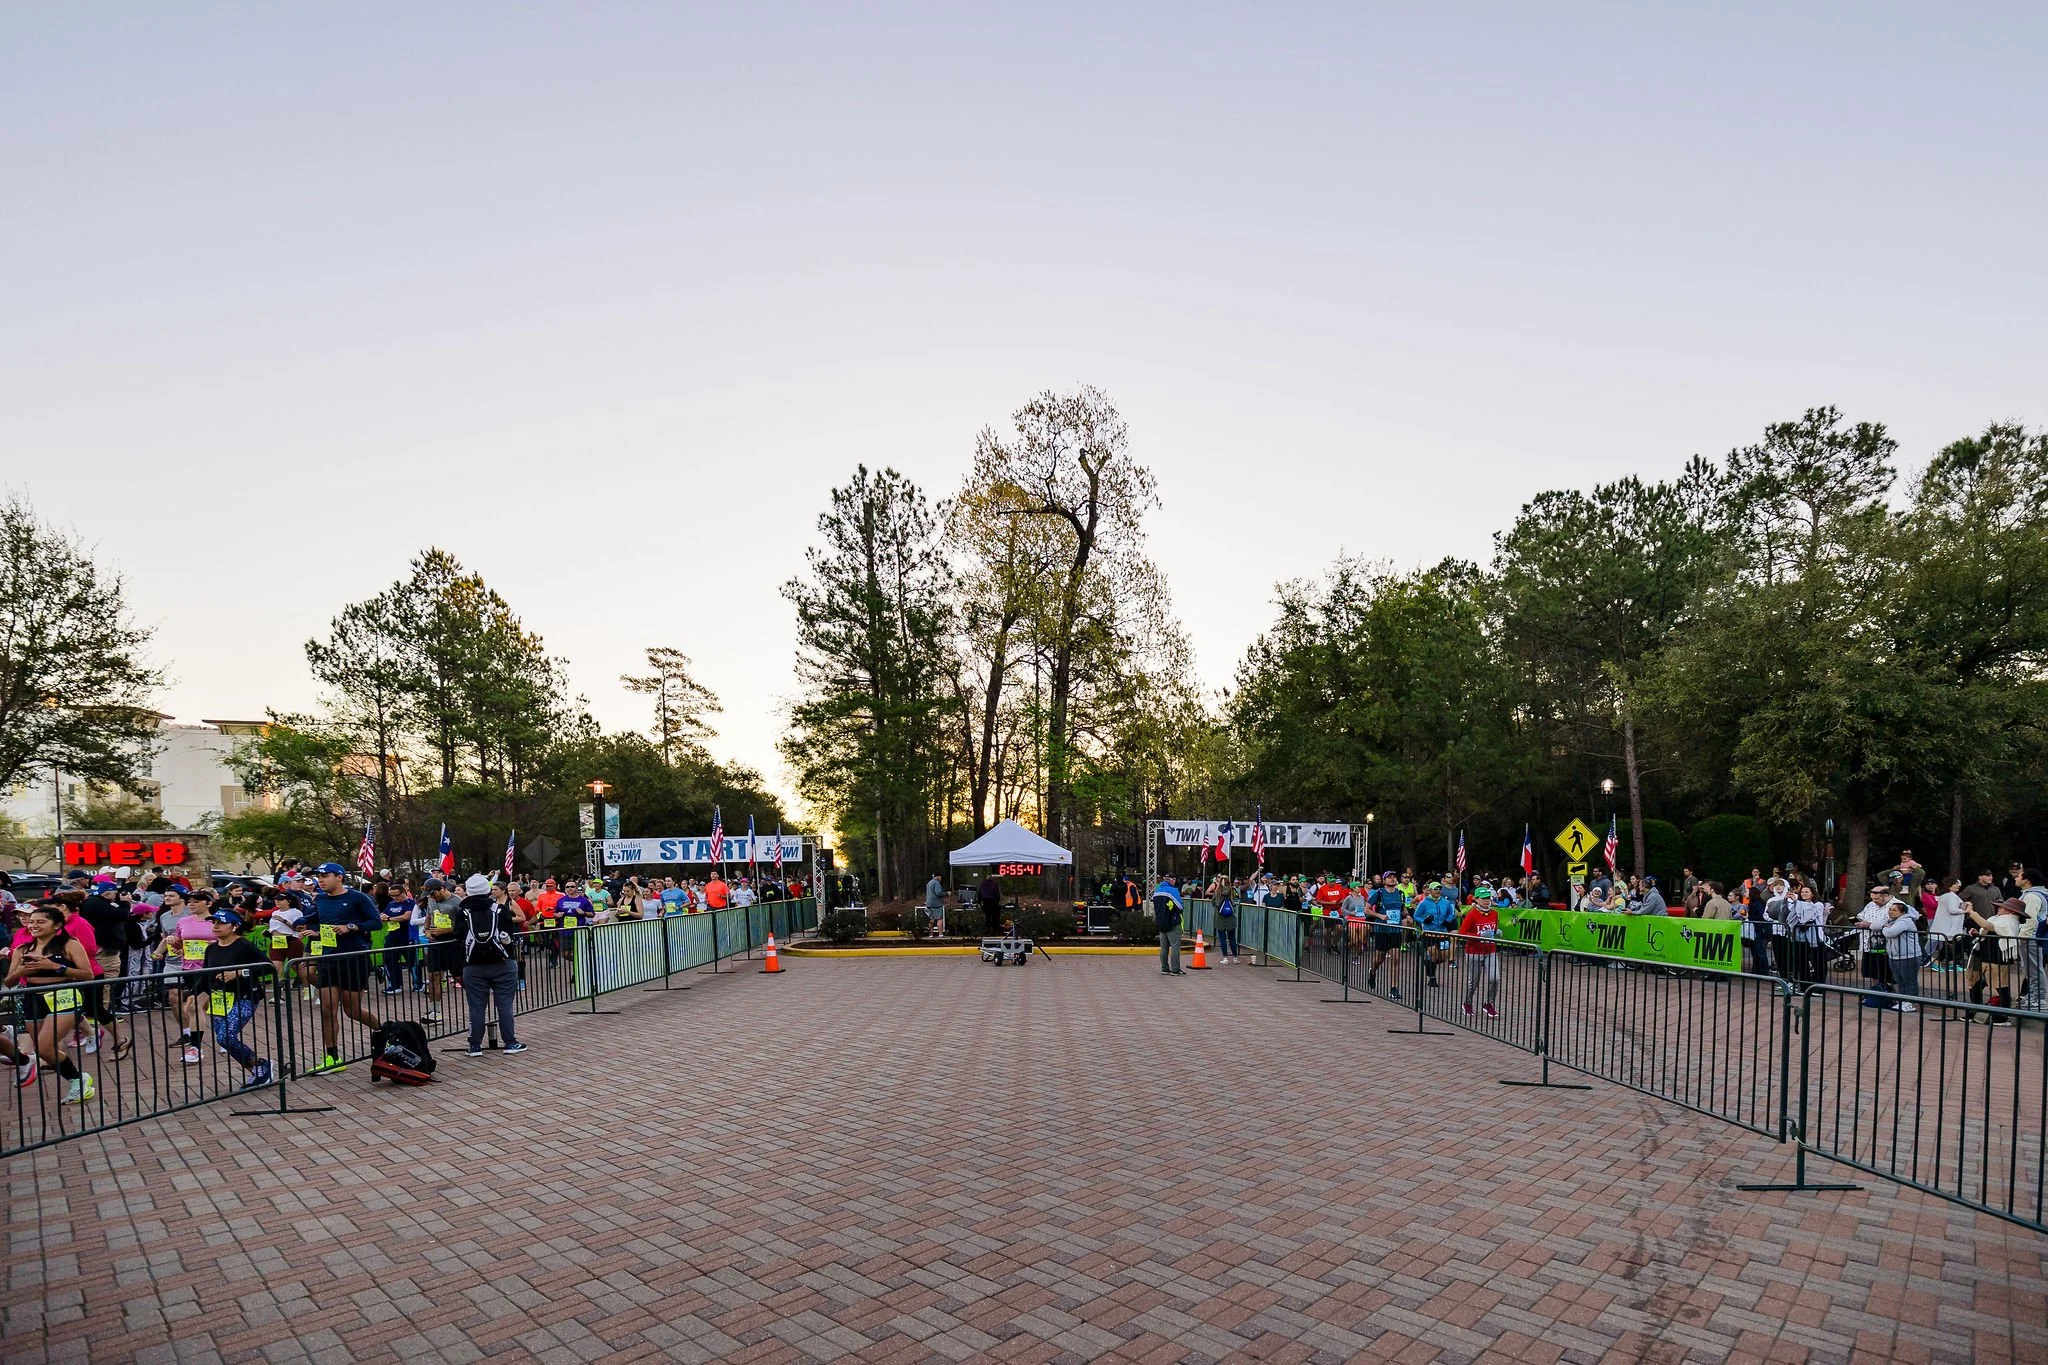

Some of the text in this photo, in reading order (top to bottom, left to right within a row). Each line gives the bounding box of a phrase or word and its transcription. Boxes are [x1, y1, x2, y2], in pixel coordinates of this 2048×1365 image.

[1175, 828, 1200, 842] TWM
[1322, 831, 1347, 845] TWM
[620, 849, 642, 862] TWM
[660, 839, 748, 861] START
[1518, 918, 1542, 940] TWM
[1597, 923, 1627, 950] TWM
[1646, 923, 1664, 952] LC
[1693, 931, 1735, 962] TWM
